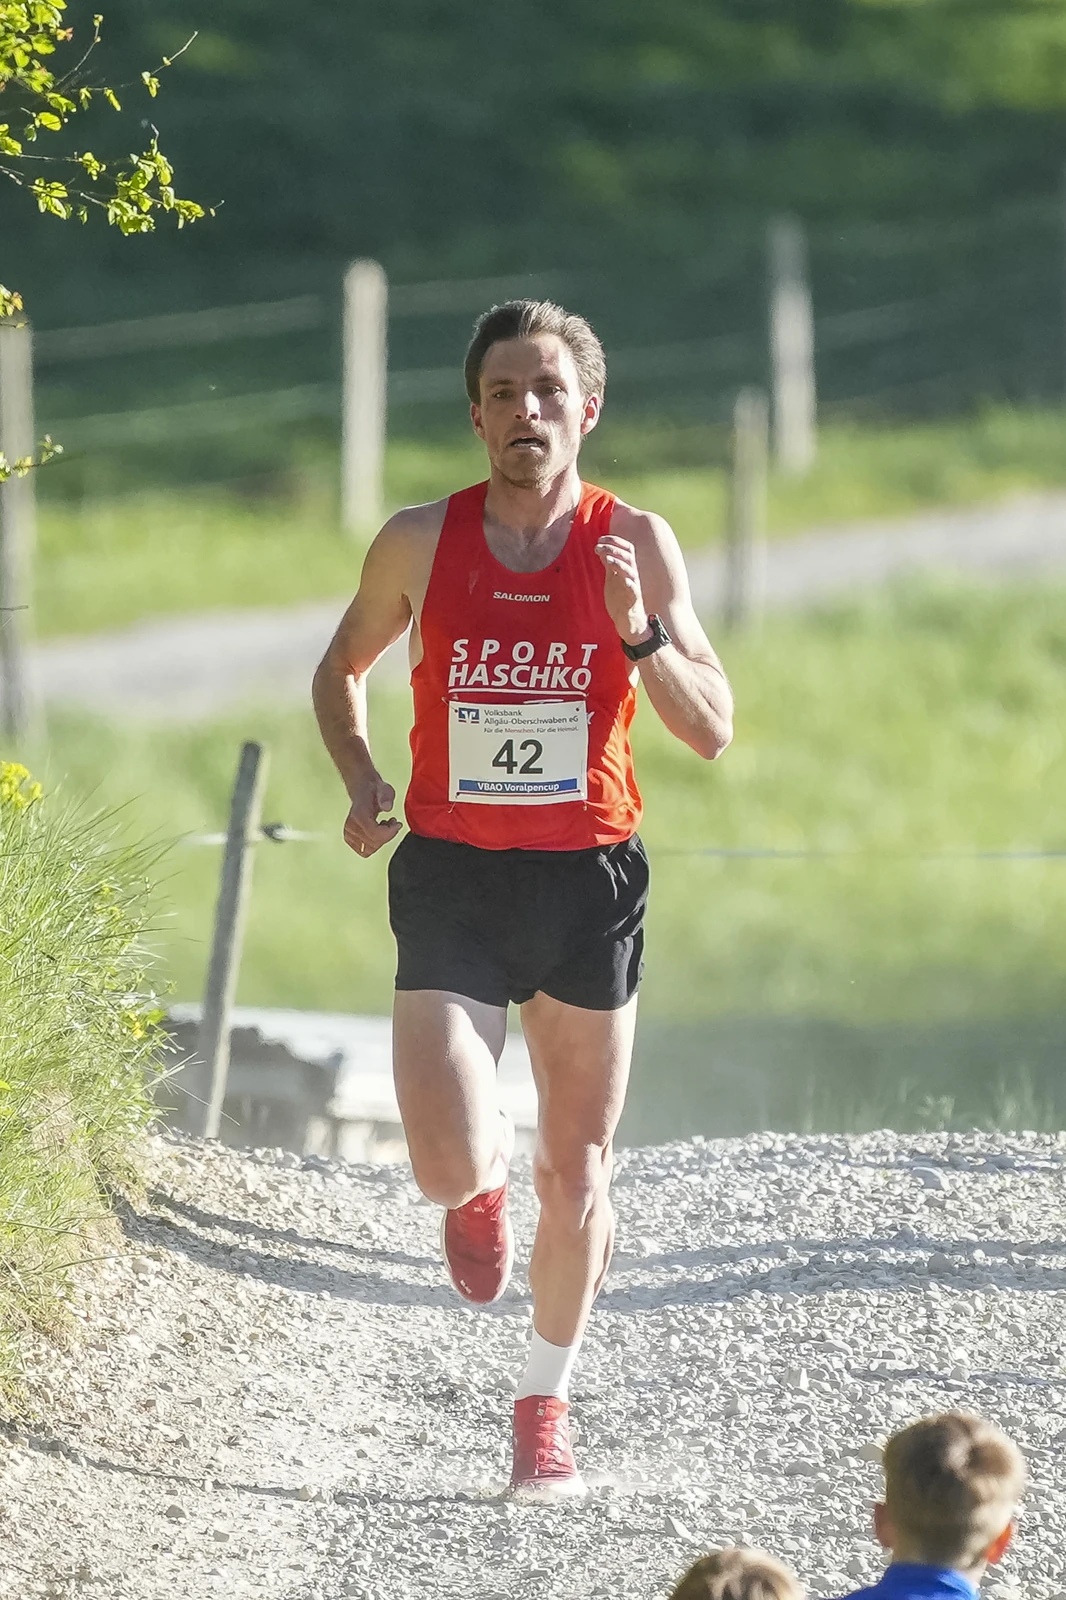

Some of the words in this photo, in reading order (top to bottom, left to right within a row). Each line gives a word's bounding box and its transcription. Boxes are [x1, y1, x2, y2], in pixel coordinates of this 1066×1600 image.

[493, 591, 550, 602] SALOMON
[451, 639, 598, 666] SPORT
[447, 664, 592, 689] HASCHKO
[484, 717, 567, 726] Allgäu-Oberschwaben
[492, 739, 543, 774] 42
[477, 782, 502, 791] VBAO
[504, 784, 560, 793] Voralpencup
